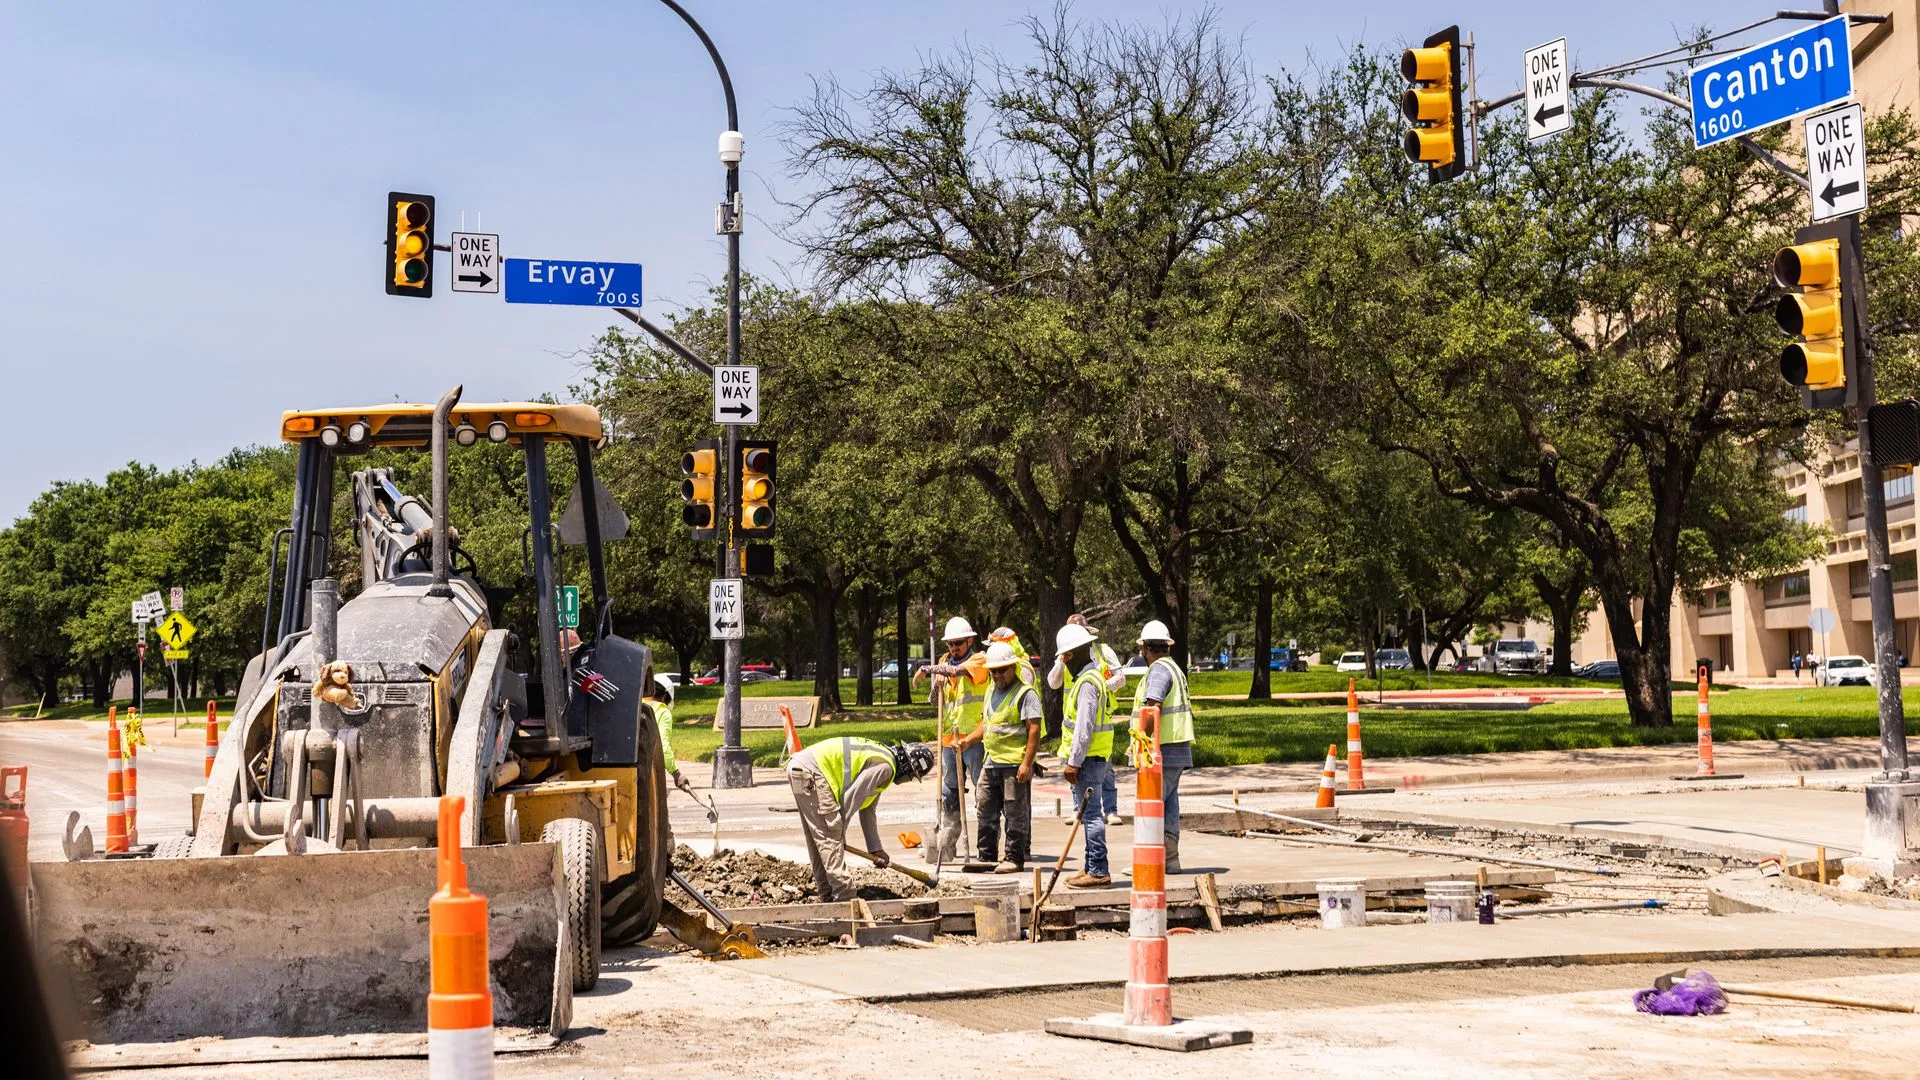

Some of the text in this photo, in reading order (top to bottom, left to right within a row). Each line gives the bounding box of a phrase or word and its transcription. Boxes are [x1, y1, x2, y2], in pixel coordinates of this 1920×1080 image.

[1531, 48, 1561, 76] ONE
[1703, 37, 1834, 109] Canton
[1532, 71, 1561, 100] WAY
[1700, 109, 1744, 140] 1600
[1815, 114, 1853, 146] ONE
[1817, 142, 1856, 174] WAY
[459, 237, 491, 252] ONE
[460, 253, 492, 268] WAY
[528, 261, 615, 292] Ervay
[596, 291, 640, 305] 700 S
[721, 370, 751, 384] ONE
[721, 386, 752, 399] WAY
[145, 593, 159, 602] ONE
[714, 585, 735, 598] ONE
[147, 599, 160, 608] WAY
[714, 601, 736, 614] WAY
